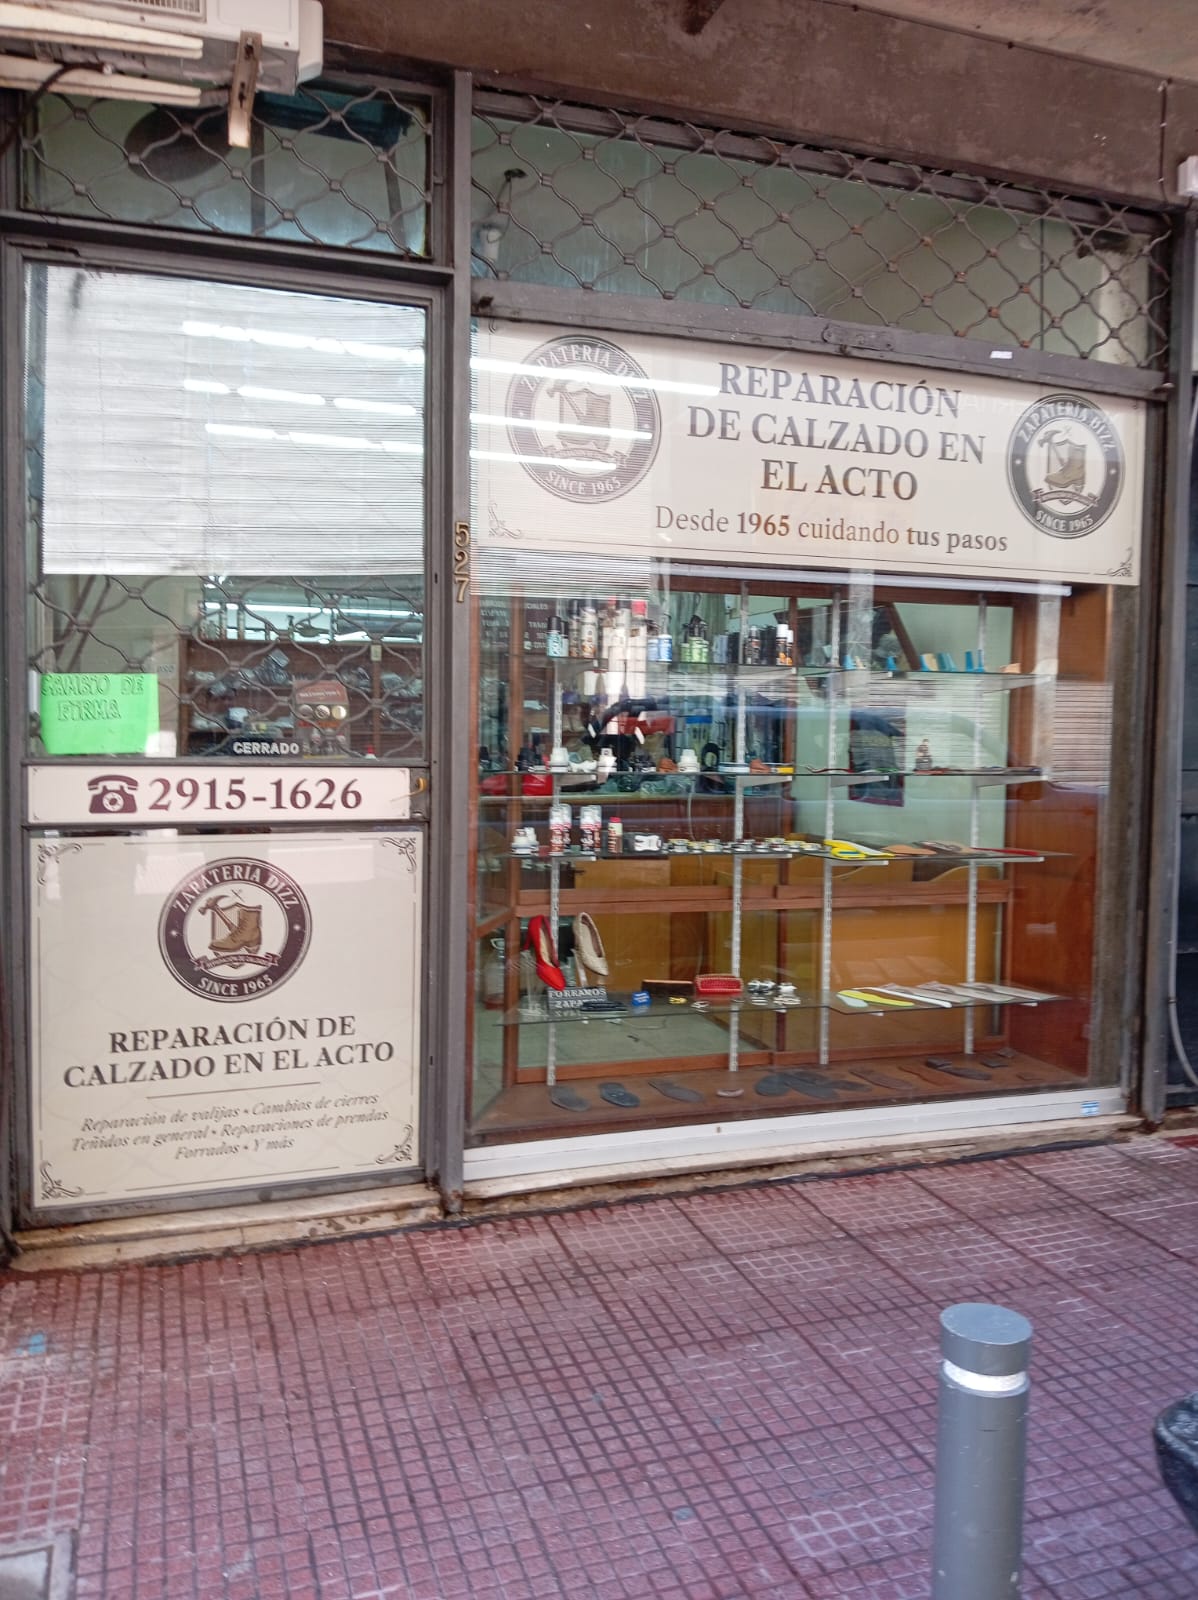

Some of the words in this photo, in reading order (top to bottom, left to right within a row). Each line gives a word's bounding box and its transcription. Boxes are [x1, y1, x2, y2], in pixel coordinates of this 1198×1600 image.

[719, 362, 962, 419] REPARACIÓN
[687, 405, 741, 441] DE
[752, 412, 929, 459] CALZADO
[938, 431, 987, 465] EN
[545, 470, 586, 496] SINCE
[591, 476, 622, 496] 1965
[760, 458, 808, 493] EL
[814, 464, 918, 501] ACTO
[655, 505, 729, 533] Desde
[737, 511, 790, 537] 1965
[798, 517, 900, 544] cuidando
[906, 526, 940, 547] tus
[945, 531, 1008, 554] pasos
[1035, 510, 1067, 532] SINCE
[1068, 514, 1094, 532] 1965
[454, 521, 470, 603] 527
[232, 742, 300, 755] CERRADO
[148, 777, 363, 811] 2915-1626
[264, 873, 300, 910] DIZZ
[198, 977, 239, 996] SINCE
[242, 974, 273, 994] 1965
[109, 1016, 309, 1054] REPARACIÓN
[315, 1014, 357, 1038] DE
[63, 1055, 216, 1088] CALZADO
[223, 1051, 264, 1075] EN
[272, 1047, 309, 1071] EL
[315, 1041, 395, 1068] ACTO
[72, 1133, 130, 1152] Teñidos
[132, 1135, 151, 1146] en
[153, 1125, 210, 1147] general
[220, 1119, 314, 1139] Reparaciones
[316, 1114, 334, 1128] de
[333, 1108, 390, 1129] prendas
[81, 1112, 167, 1133] Reparación
[170, 1109, 188, 1124] de
[191, 1106, 240, 1123] valijas
[252, 1099, 312, 1116] Cambios
[314, 1096, 333, 1110] de
[333, 1094, 379, 1108] cierres
[174, 1141, 240, 1160] Forrados
[253, 1138, 265, 1152] Y
[266, 1136, 295, 1151] más
